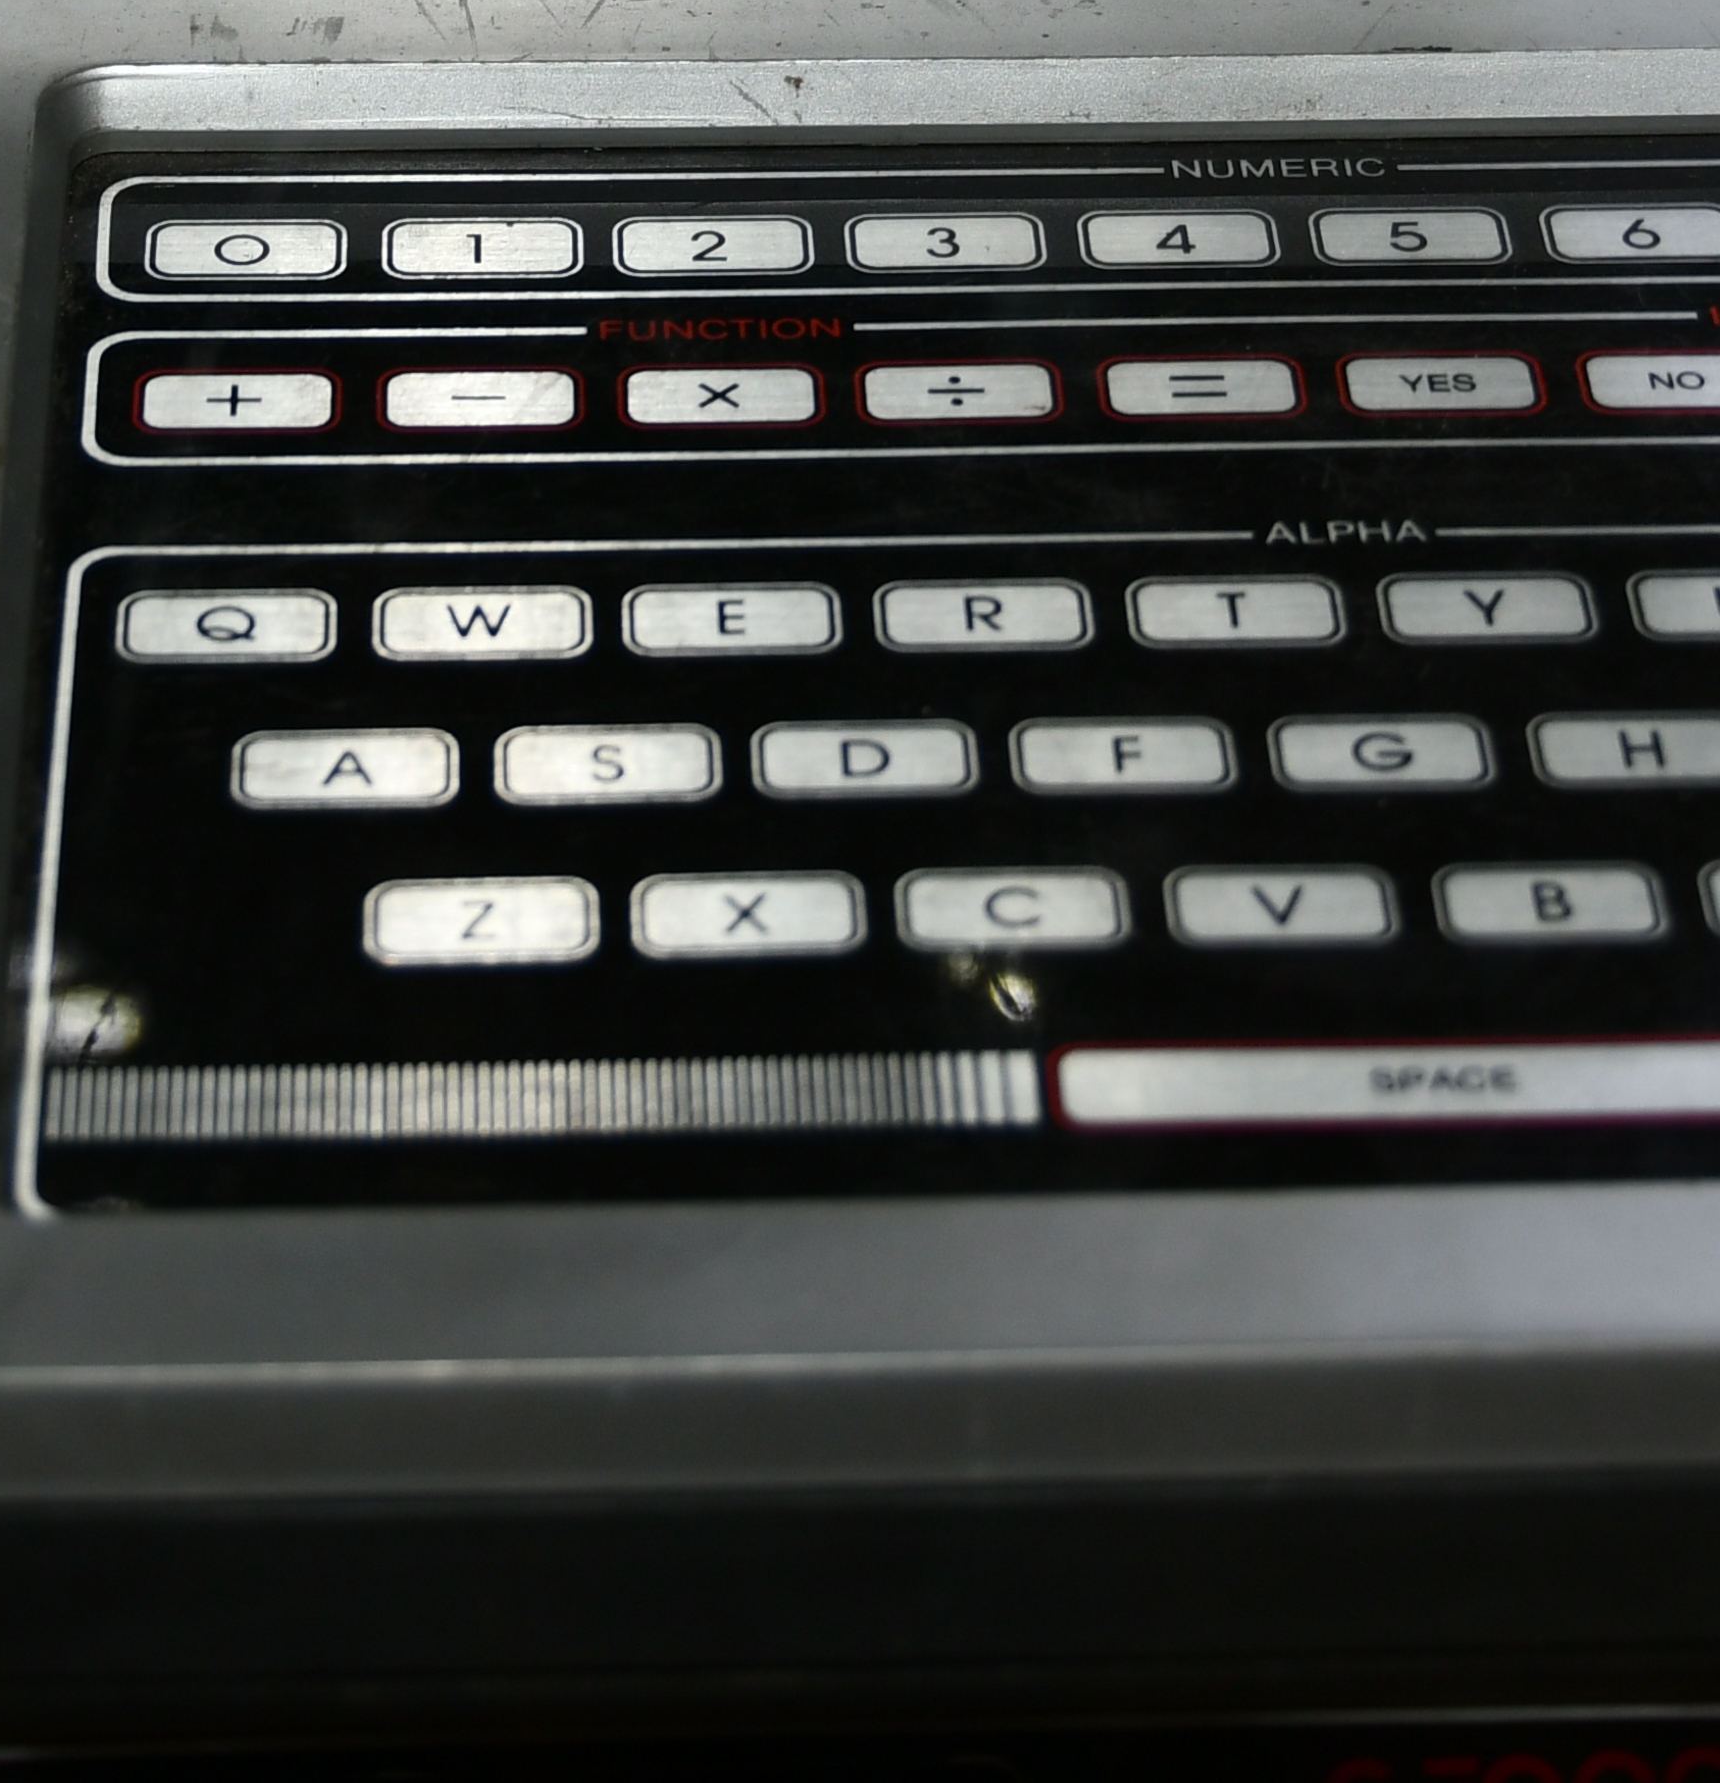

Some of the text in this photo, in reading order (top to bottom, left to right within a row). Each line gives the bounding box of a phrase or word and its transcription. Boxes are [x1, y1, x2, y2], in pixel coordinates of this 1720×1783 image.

[1170, 156, 1386, 180] NUMERIC
[464, 231, 484, 266] 1
[689, 228, 730, 264] 2
[924, 225, 963, 261] 3
[1154, 222, 1198, 257] 4
[1388, 219, 1430, 255] 5
[1620, 216, 1664, 252] 6
[598, 316, 843, 342] FUNCTION
[1399, 371, 1478, 394] YES
[1647, 370, 1707, 391] NO
[1265, 518, 1427, 545] ALPHA
[193, 603, 258, 645] Q
[445, 603, 513, 640] W
[715, 597, 747, 638] E
[961, 593, 1005, 634] R
[1215, 589, 1248, 631] T
[1461, 587, 1507, 629] Y
[320, 748, 374, 788] A
[589, 742, 627, 785] S
[838, 737, 893, 780] D
[1110, 733, 1143, 776] F
[1350, 729, 1416, 775] G
[1616, 728, 1669, 771] H
[459, 899, 497, 943] Z
[724, 892, 769, 935] X
[981, 883, 1042, 931] C
[1250, 883, 1305, 929] V
[1528, 878, 1576, 926] B
[1370, 1066, 1517, 1096] SPACE
